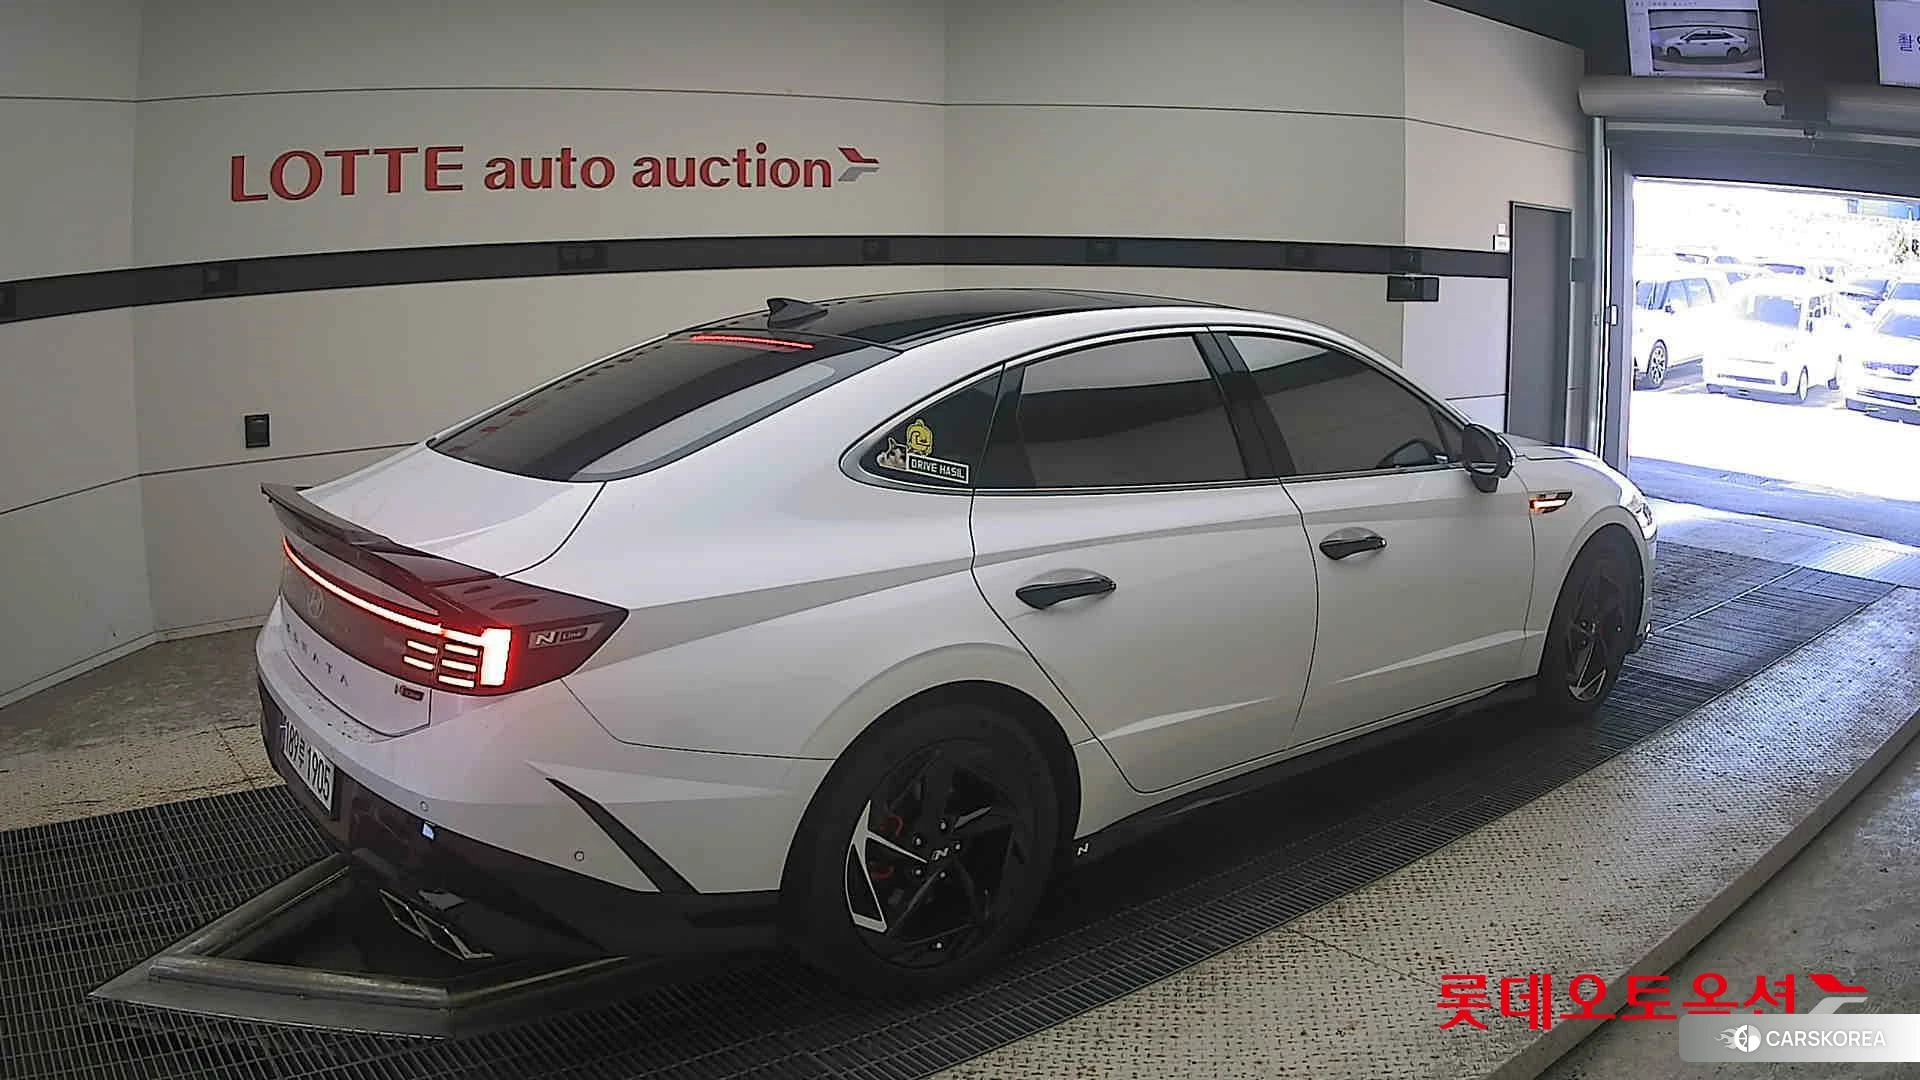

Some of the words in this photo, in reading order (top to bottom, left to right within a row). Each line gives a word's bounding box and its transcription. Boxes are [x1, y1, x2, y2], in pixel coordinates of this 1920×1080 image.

[231, 145, 464, 202] LOTTE
[485, 147, 616, 190] auto
[632, 143, 832, 189] auction
[911, 458, 938, 473] DRIVE
[939, 464, 965, 479] HASIL
[535, 631, 556, 645] N
[307, 746, 331, 801] 1905
